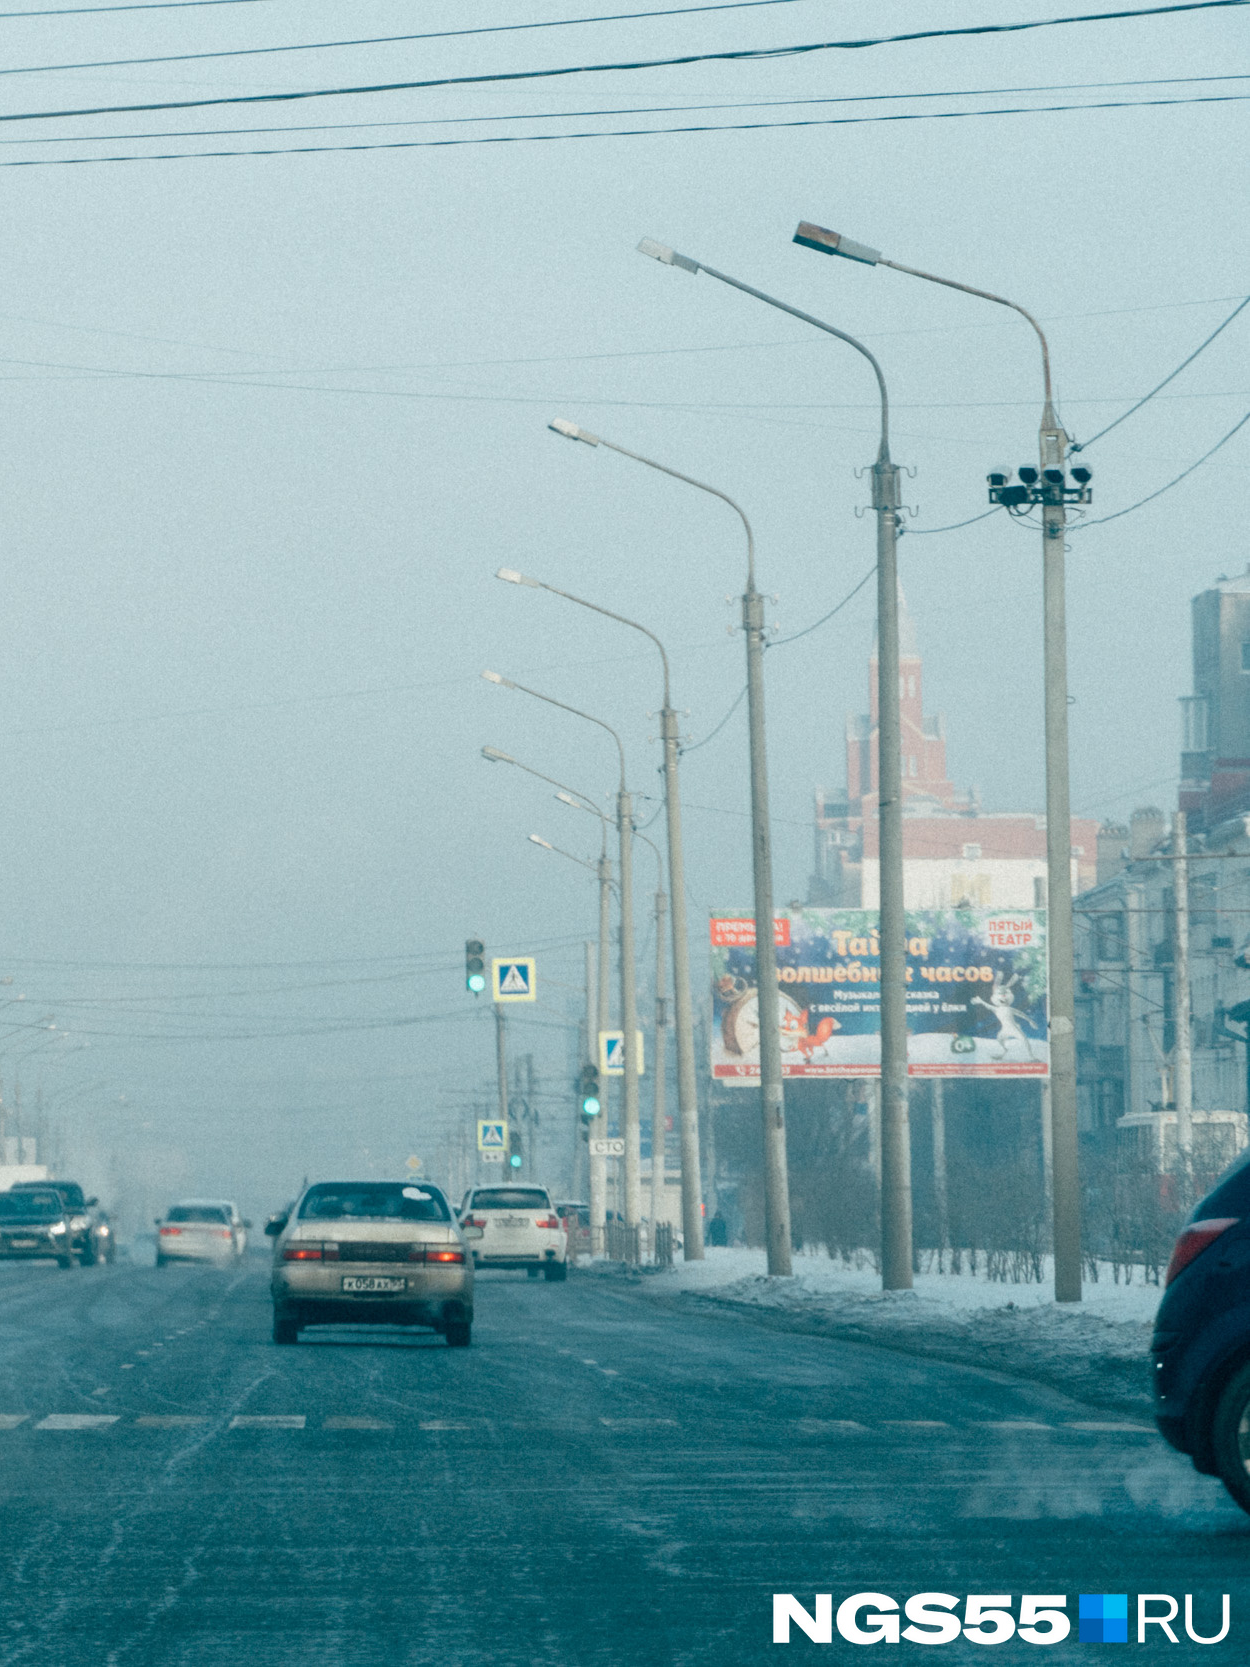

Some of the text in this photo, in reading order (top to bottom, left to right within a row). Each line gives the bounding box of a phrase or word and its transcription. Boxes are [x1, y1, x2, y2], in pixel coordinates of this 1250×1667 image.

[988, 919, 1033, 932] ПЯТЫЙ
[988, 933, 1033, 946] ТЕАТР
[920, 966, 994, 983] часов
[594, 1142, 624, 1153] СТО
